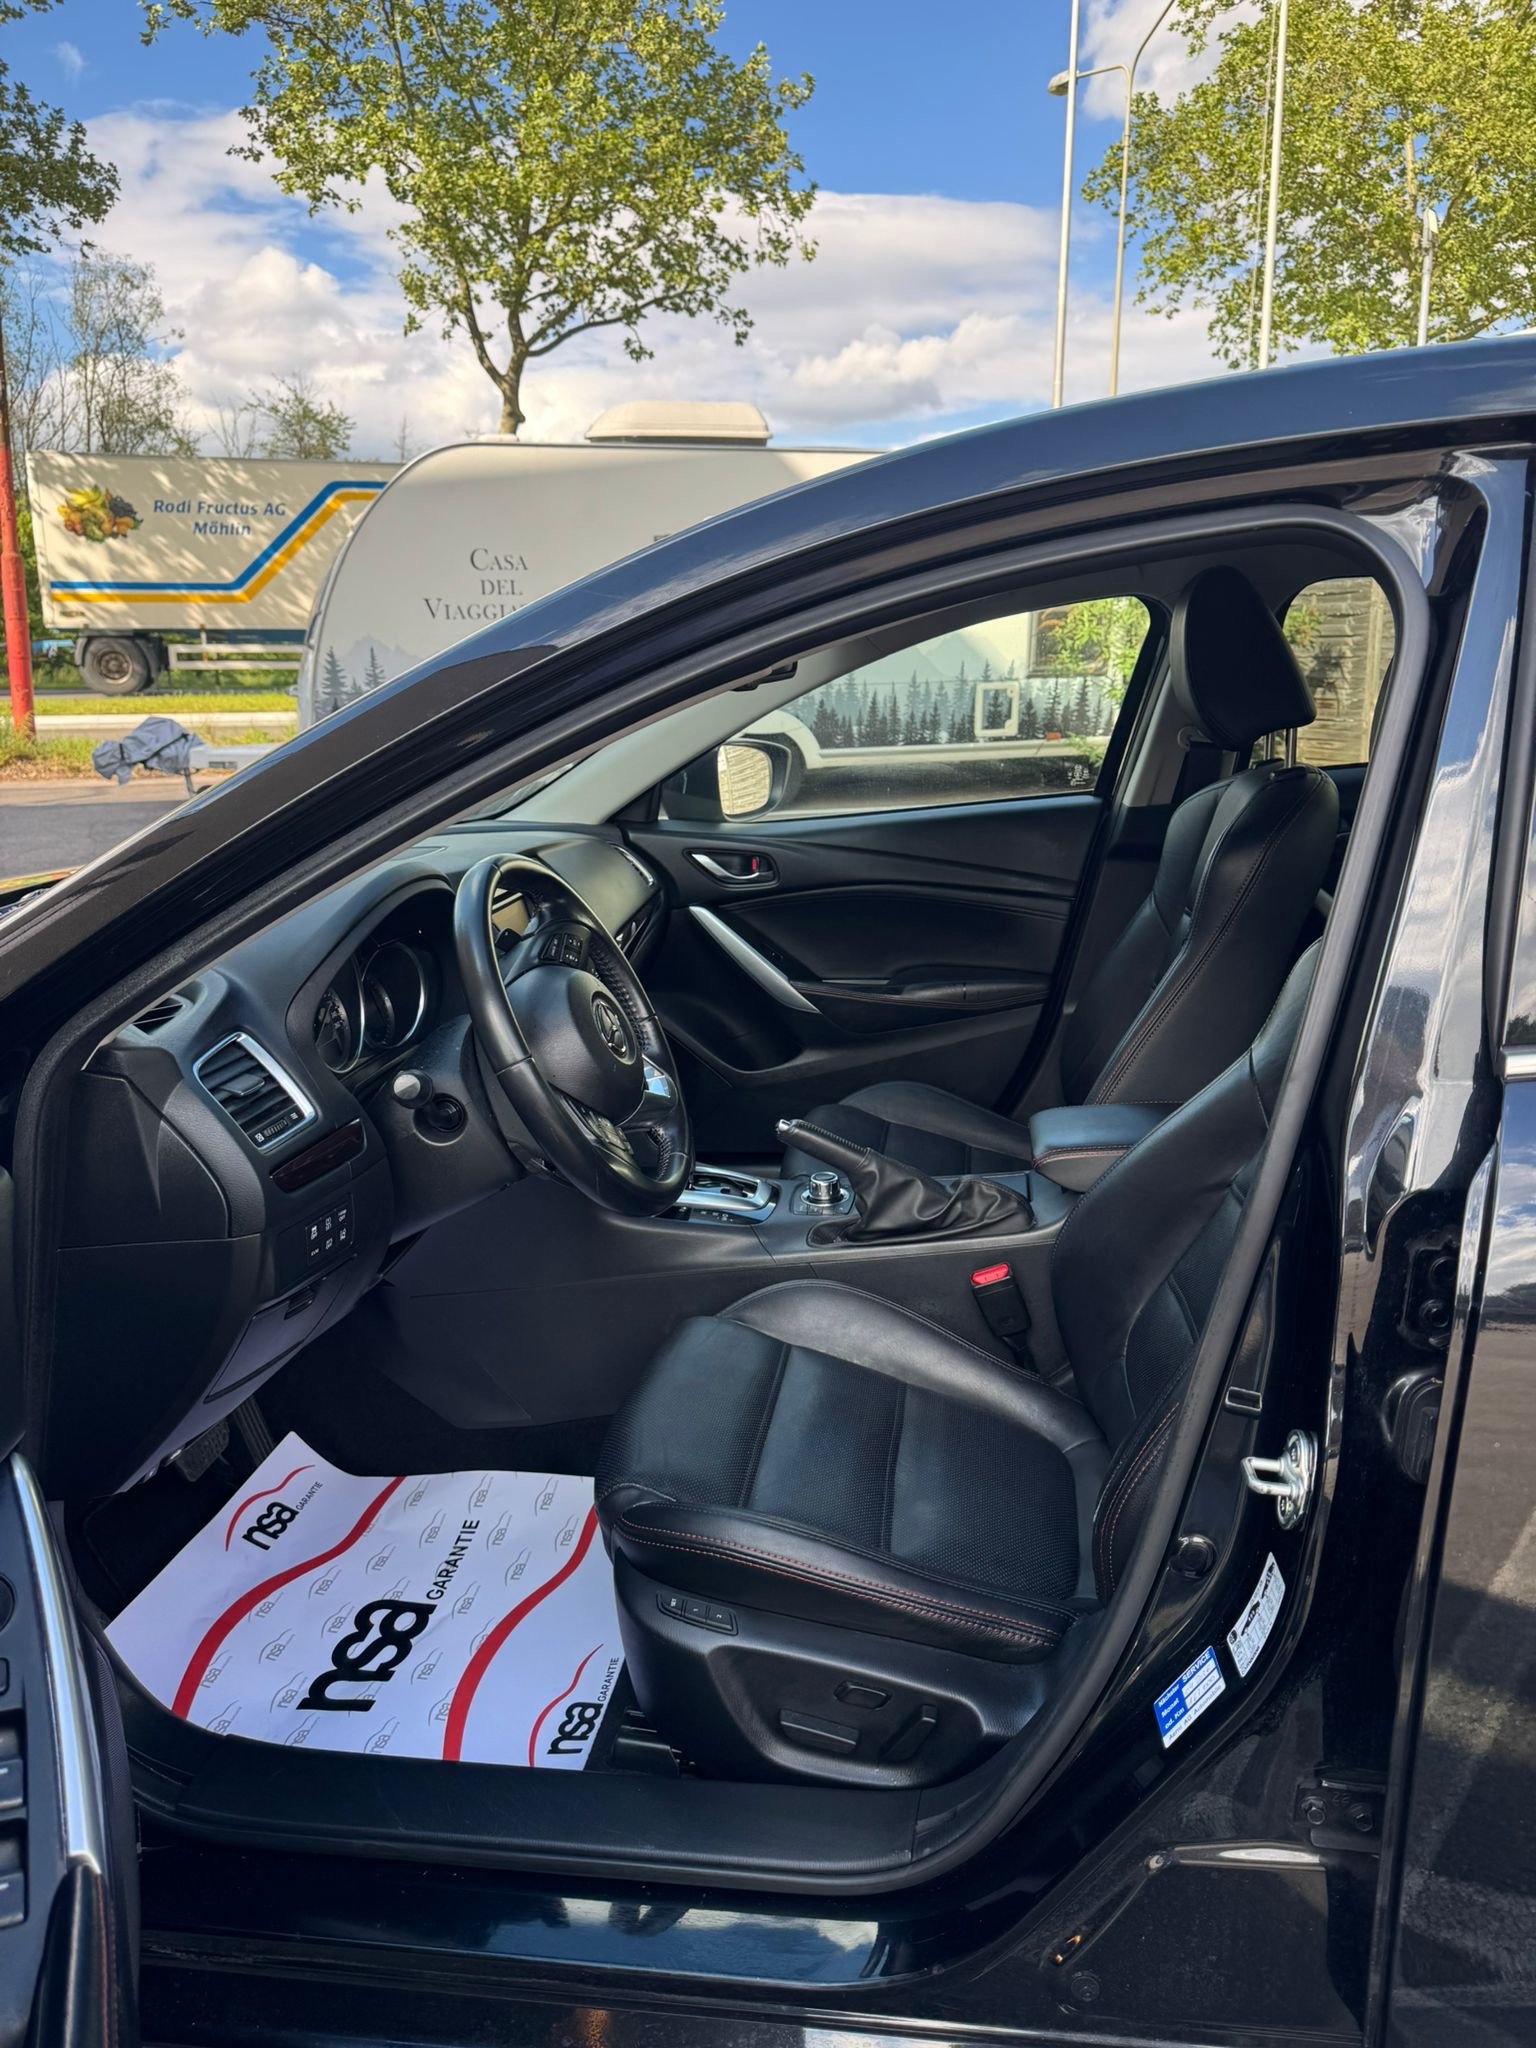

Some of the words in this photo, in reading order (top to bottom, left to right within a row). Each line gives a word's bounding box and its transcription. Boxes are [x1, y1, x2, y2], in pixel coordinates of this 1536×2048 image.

[153, 500, 192, 514] Rodi
[197, 501, 258, 515] Fructus
[263, 502, 287, 516] AG
[193, 521, 251, 536] Möhlin
[423, 598, 524, 620] VIAGGI
[242, 1502, 299, 1550] nsa
[295, 1481, 323, 1511] GARANTIE
[296, 1599, 438, 1712] nsa
[426, 1520, 480, 1600] GARANTIE
[1182, 1650, 1212, 1683] SERVICE
[547, 1702, 604, 1754] nsa
[597, 1657, 620, 1702] GARANTIE
[1161, 1697, 1180, 1718] Monat
